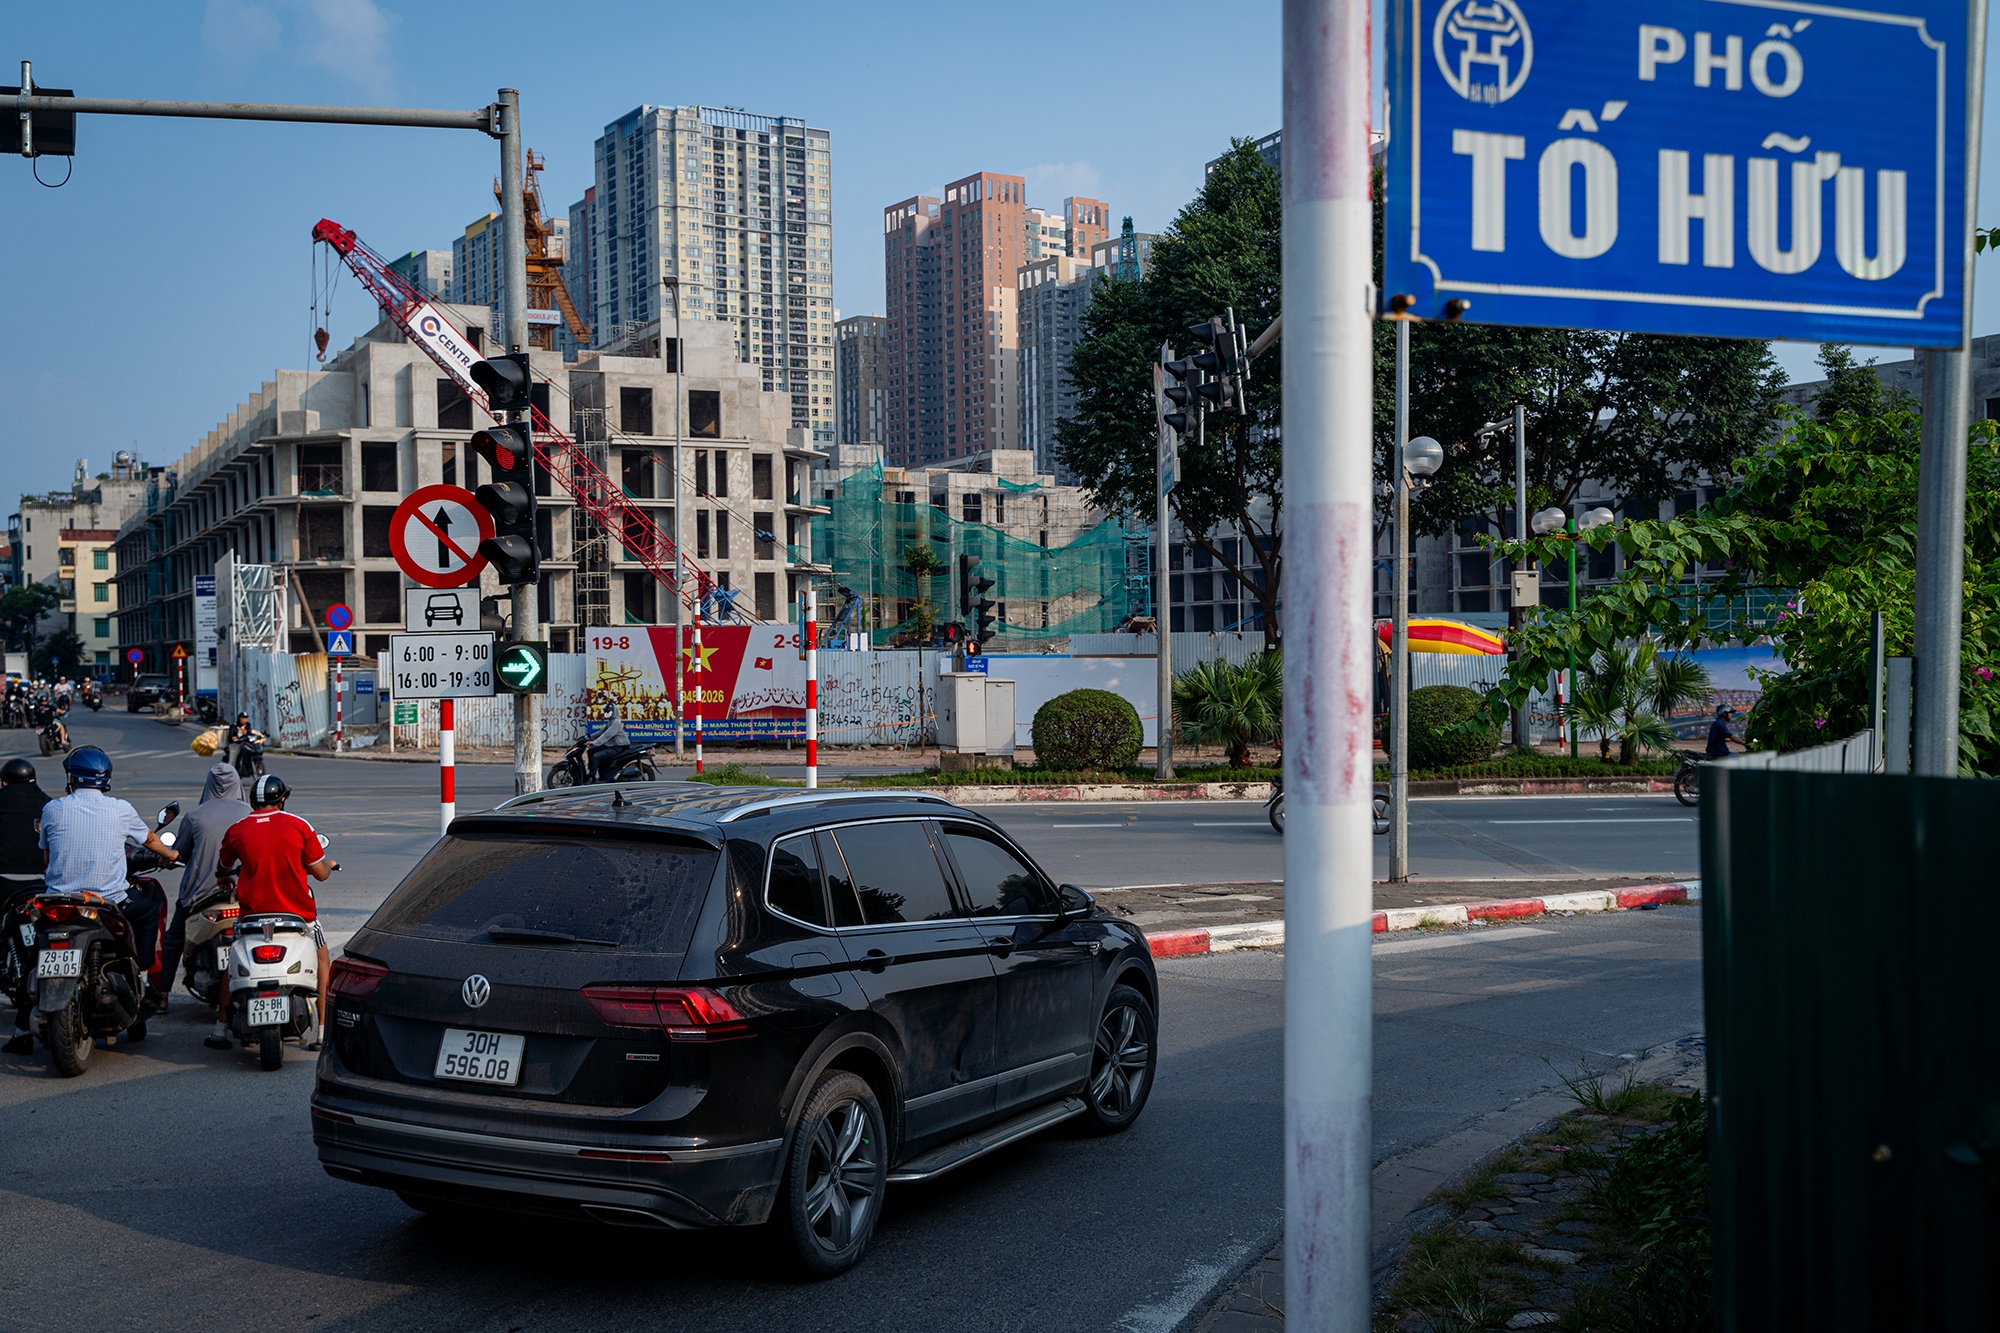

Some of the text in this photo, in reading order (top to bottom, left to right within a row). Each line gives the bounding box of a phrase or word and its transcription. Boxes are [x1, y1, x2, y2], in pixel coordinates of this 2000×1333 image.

[1639, 19, 1812, 98] PHỐ
[1452, 101, 1907, 281] TỐ HỮU
[592, 636, 630, 650] 19-8
[774, 633, 800, 649] 2-9
[403, 646, 434, 662] 6:00
[455, 644, 488, 661] 9:00
[44, 950, 75, 963] 29-G1
[40, 963, 77, 976] 349.05
[254, 998, 282, 1011] 29-BH
[252, 1010, 286, 1023] 111.70
[463, 1032, 501, 1055] 30H
[444, 1054, 510, 1080] 596.08
